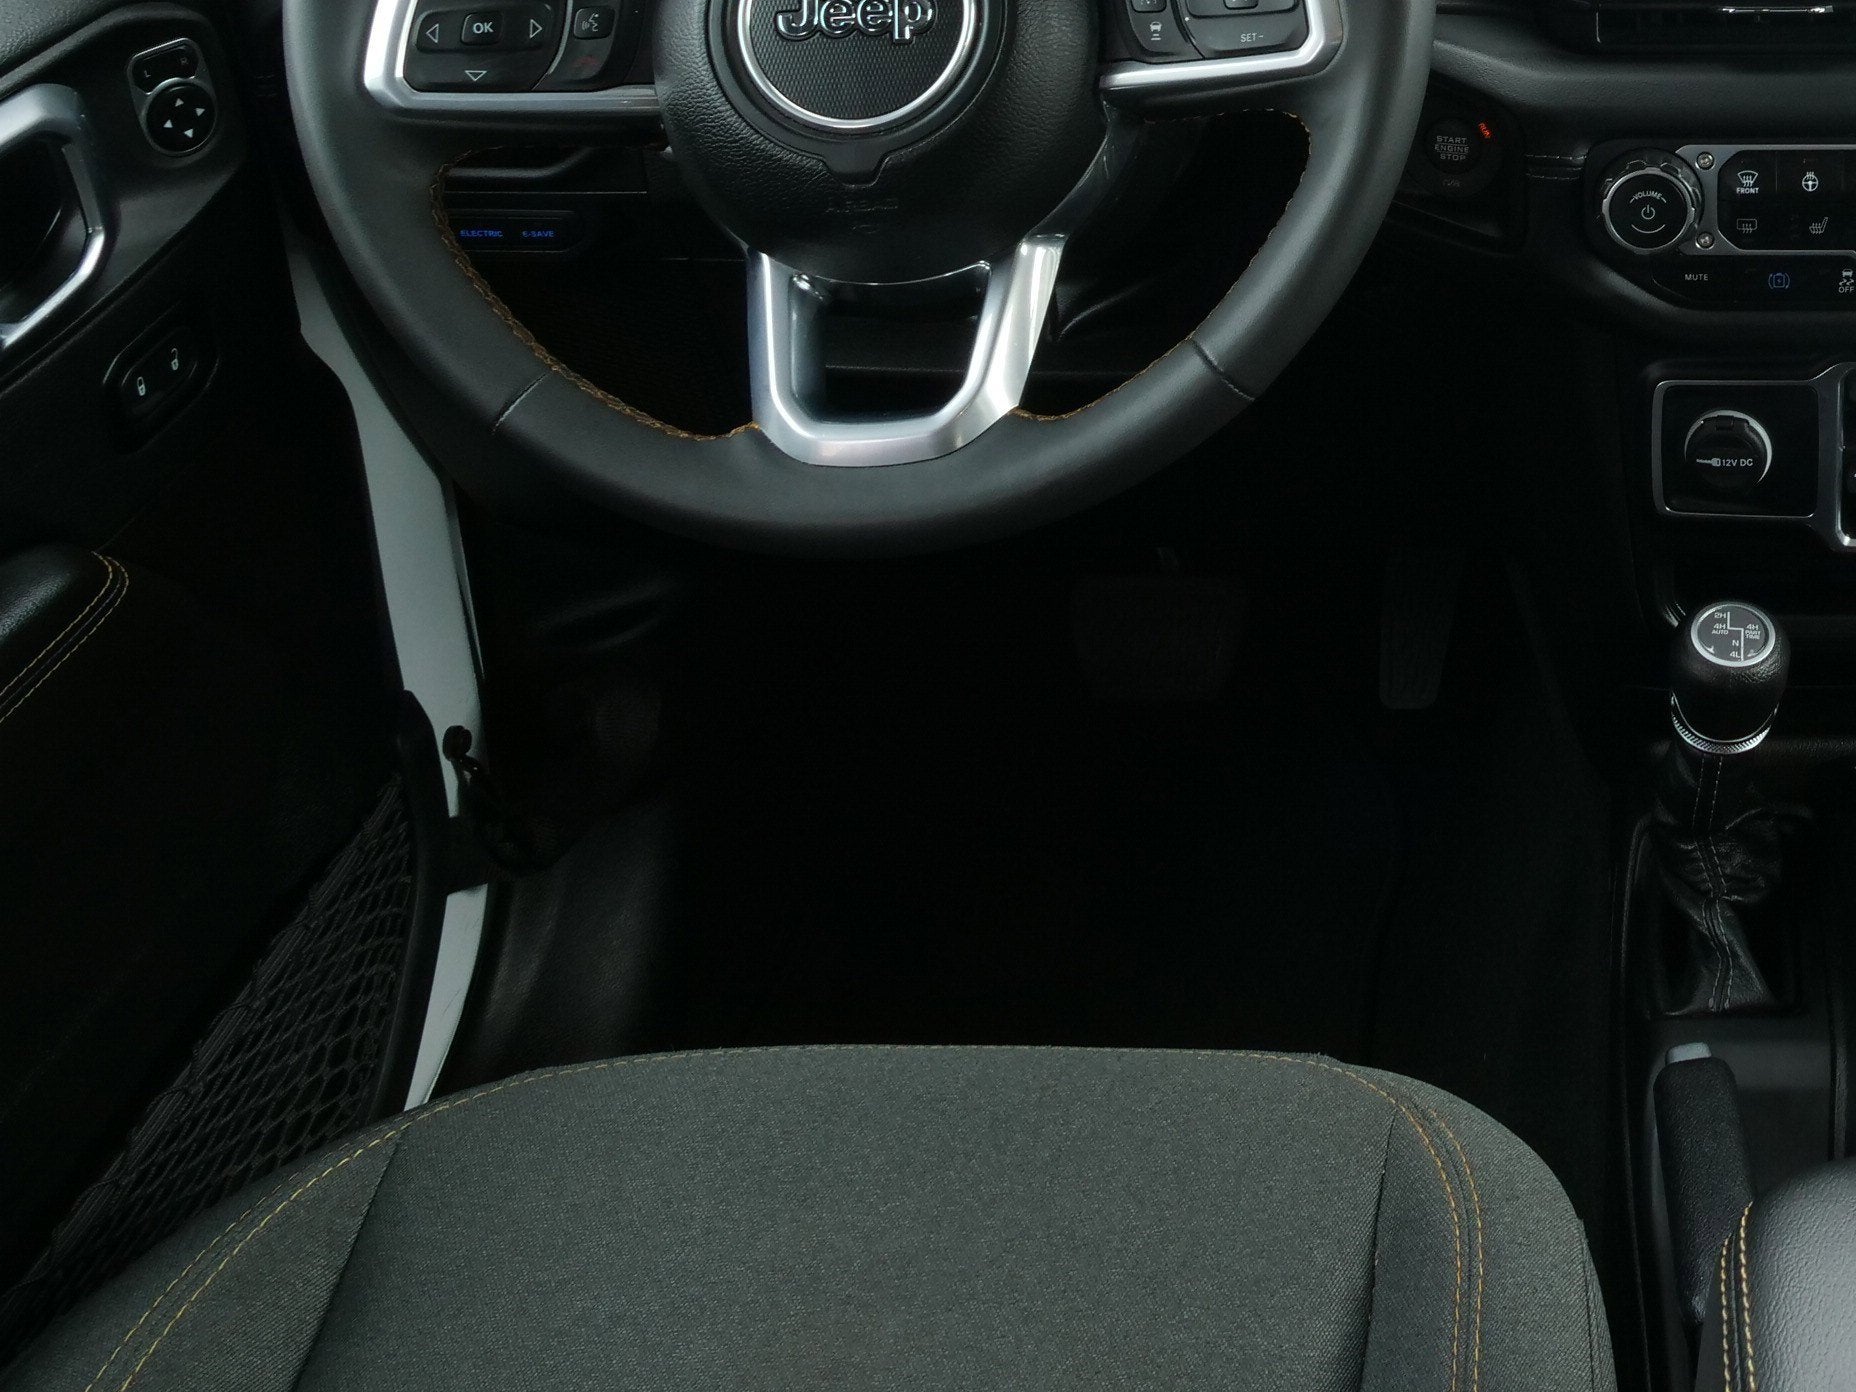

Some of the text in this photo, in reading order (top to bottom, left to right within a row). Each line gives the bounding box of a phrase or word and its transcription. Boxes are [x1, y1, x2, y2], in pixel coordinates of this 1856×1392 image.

[472, 21, 493, 34] OK
[1436, 136, 1468, 144] START
[1434, 144, 1470, 153] ENGINE
[1440, 153, 1466, 161] STOP
[1736, 187, 1760, 195] FRONT
[1632, 191, 1663, 201] VOLUME
[460, 230, 504, 238] ELECTRIC
[522, 230, 555, 238] E-SAVE
[1684, 273, 1709, 282] MUTE
[1838, 286, 1855, 294] OFF
[1722, 458, 1754, 467] 12V DC
